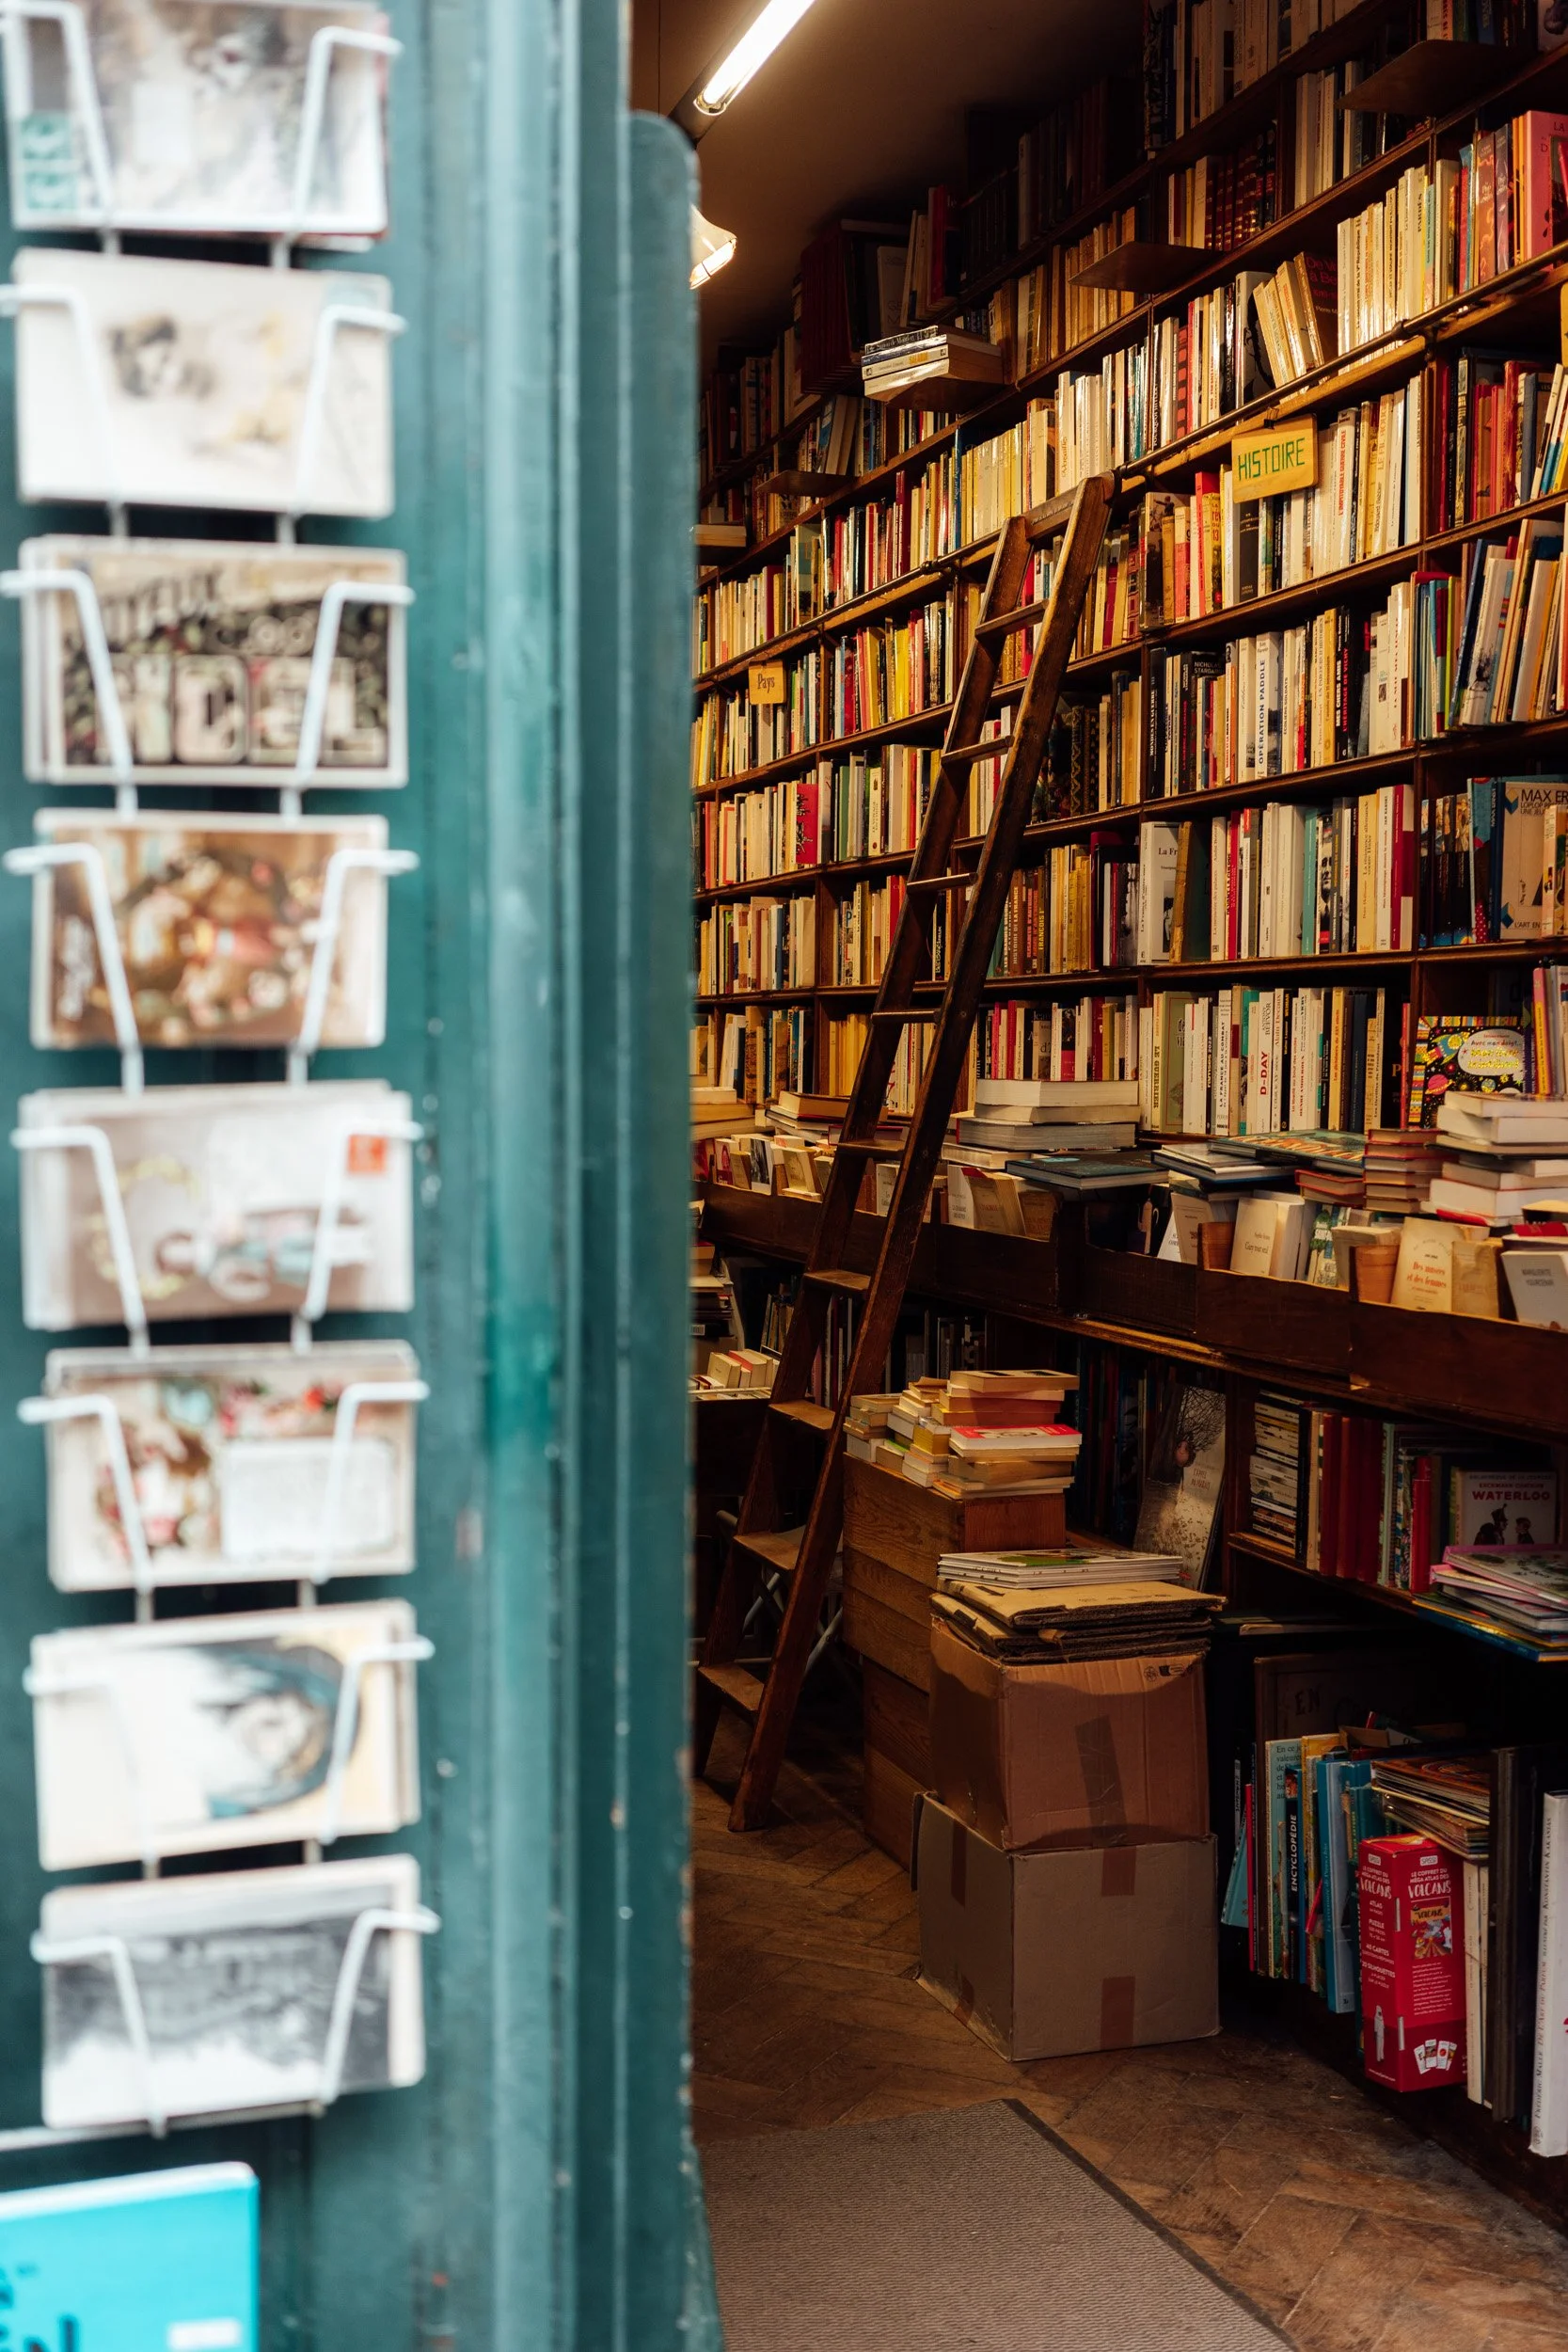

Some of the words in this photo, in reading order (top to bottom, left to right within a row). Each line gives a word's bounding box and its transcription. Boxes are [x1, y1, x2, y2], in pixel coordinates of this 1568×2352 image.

[1238, 437, 1305, 481] HISTOIRE
[757, 671, 776, 691] Pays
[1343, 675, 1348, 684] DE
[1520, 789, 1551, 803] MAX
[1158, 847, 1168, 856] La
[1014, 914, 1018, 922] LA
[1153, 1046, 1160, 1061] LE
[1220, 1053, 1225, 1063] AU
[1219, 1098, 1224, 1107] LA
[1472, 1491, 1550, 1501] WATERLOO
[1276, 1745, 1285, 1754] En
[1290, 1814, 1298, 1892] ENCYCLOPÉDIE
[1360, 1877, 1392, 1899] VOLCANS
[1408, 1880, 1451, 1899] VOLCANS
[1372, 1946, 1389, 1956] CARTES
